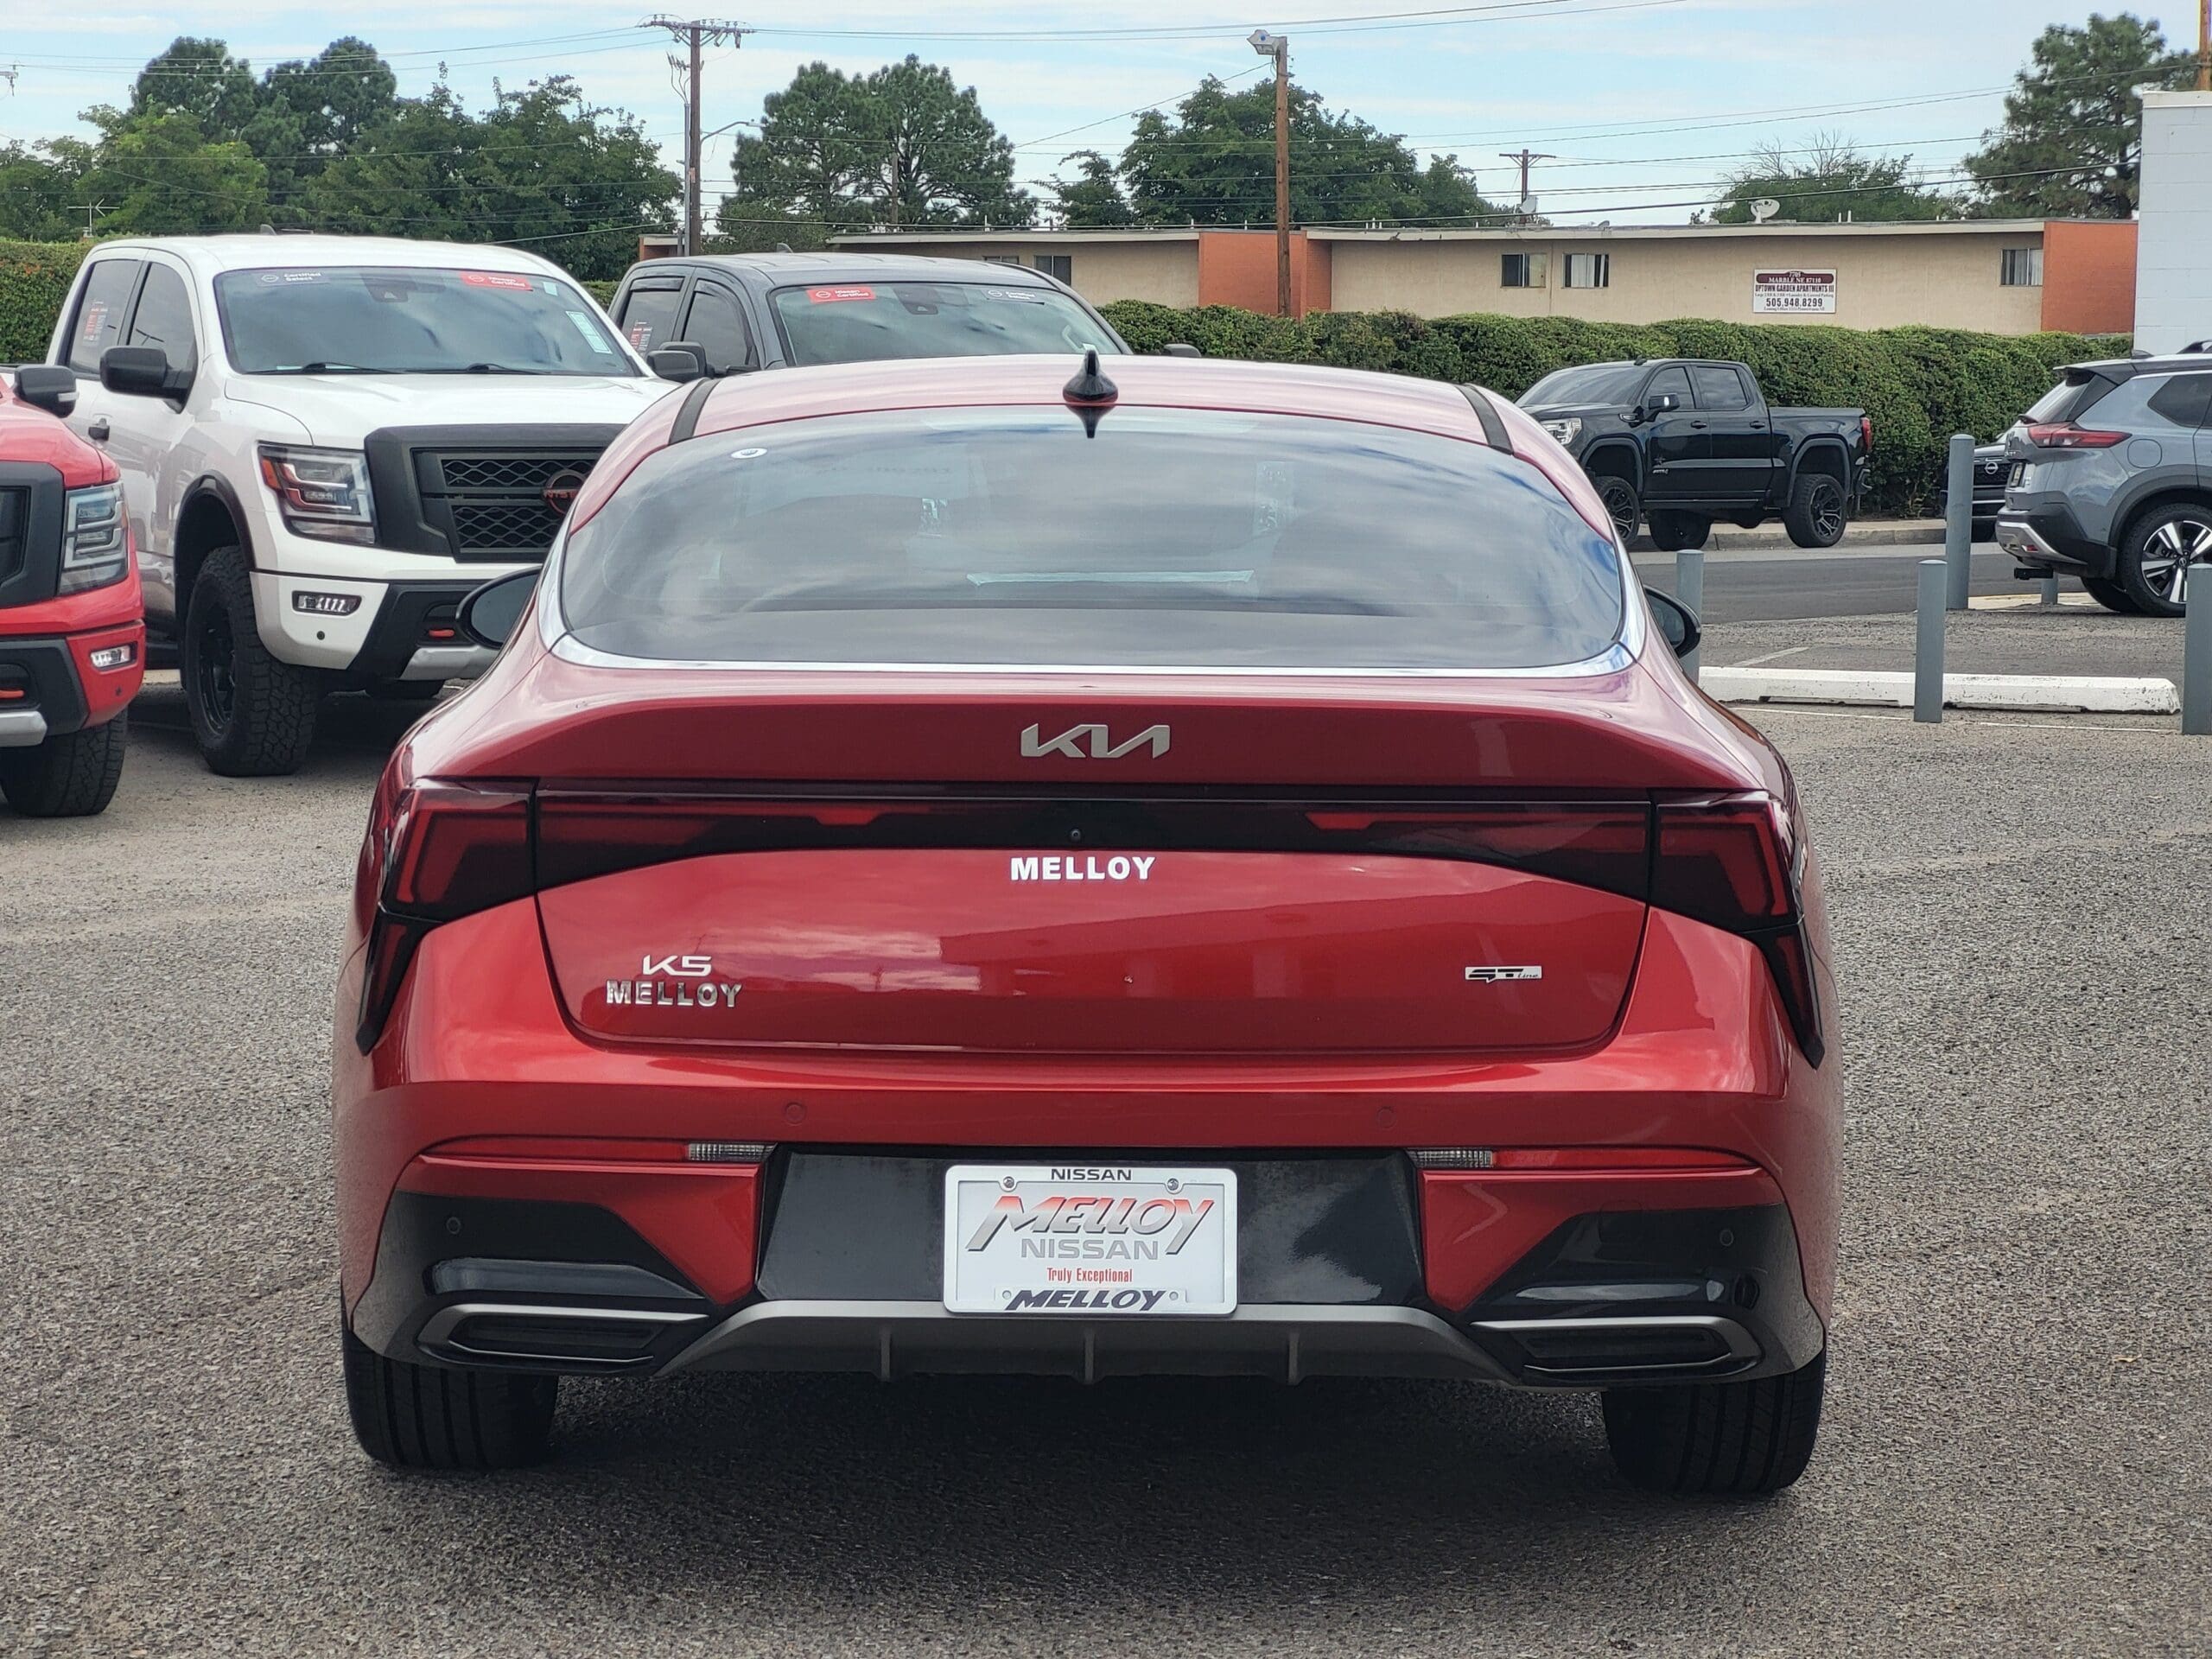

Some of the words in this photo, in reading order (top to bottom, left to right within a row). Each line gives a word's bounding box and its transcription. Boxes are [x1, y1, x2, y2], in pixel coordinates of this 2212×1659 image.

[1766, 298, 1823, 307] 505.948.8299
[1020, 723, 1170, 759] KIA
[1010, 856, 1155, 880] MELLOY
[642, 954, 712, 977] K5
[607, 980, 742, 1007] MELLOY
[1051, 1168, 1132, 1181] NISSAN
[965, 1196, 1215, 1255] MELLOY
[1020, 1238, 1159, 1260] NISSAN
[1046, 1268, 1072, 1284] Truly
[1076, 1268, 1133, 1284] Exceptional
[1005, 1289, 1167, 1311] MELLOY
